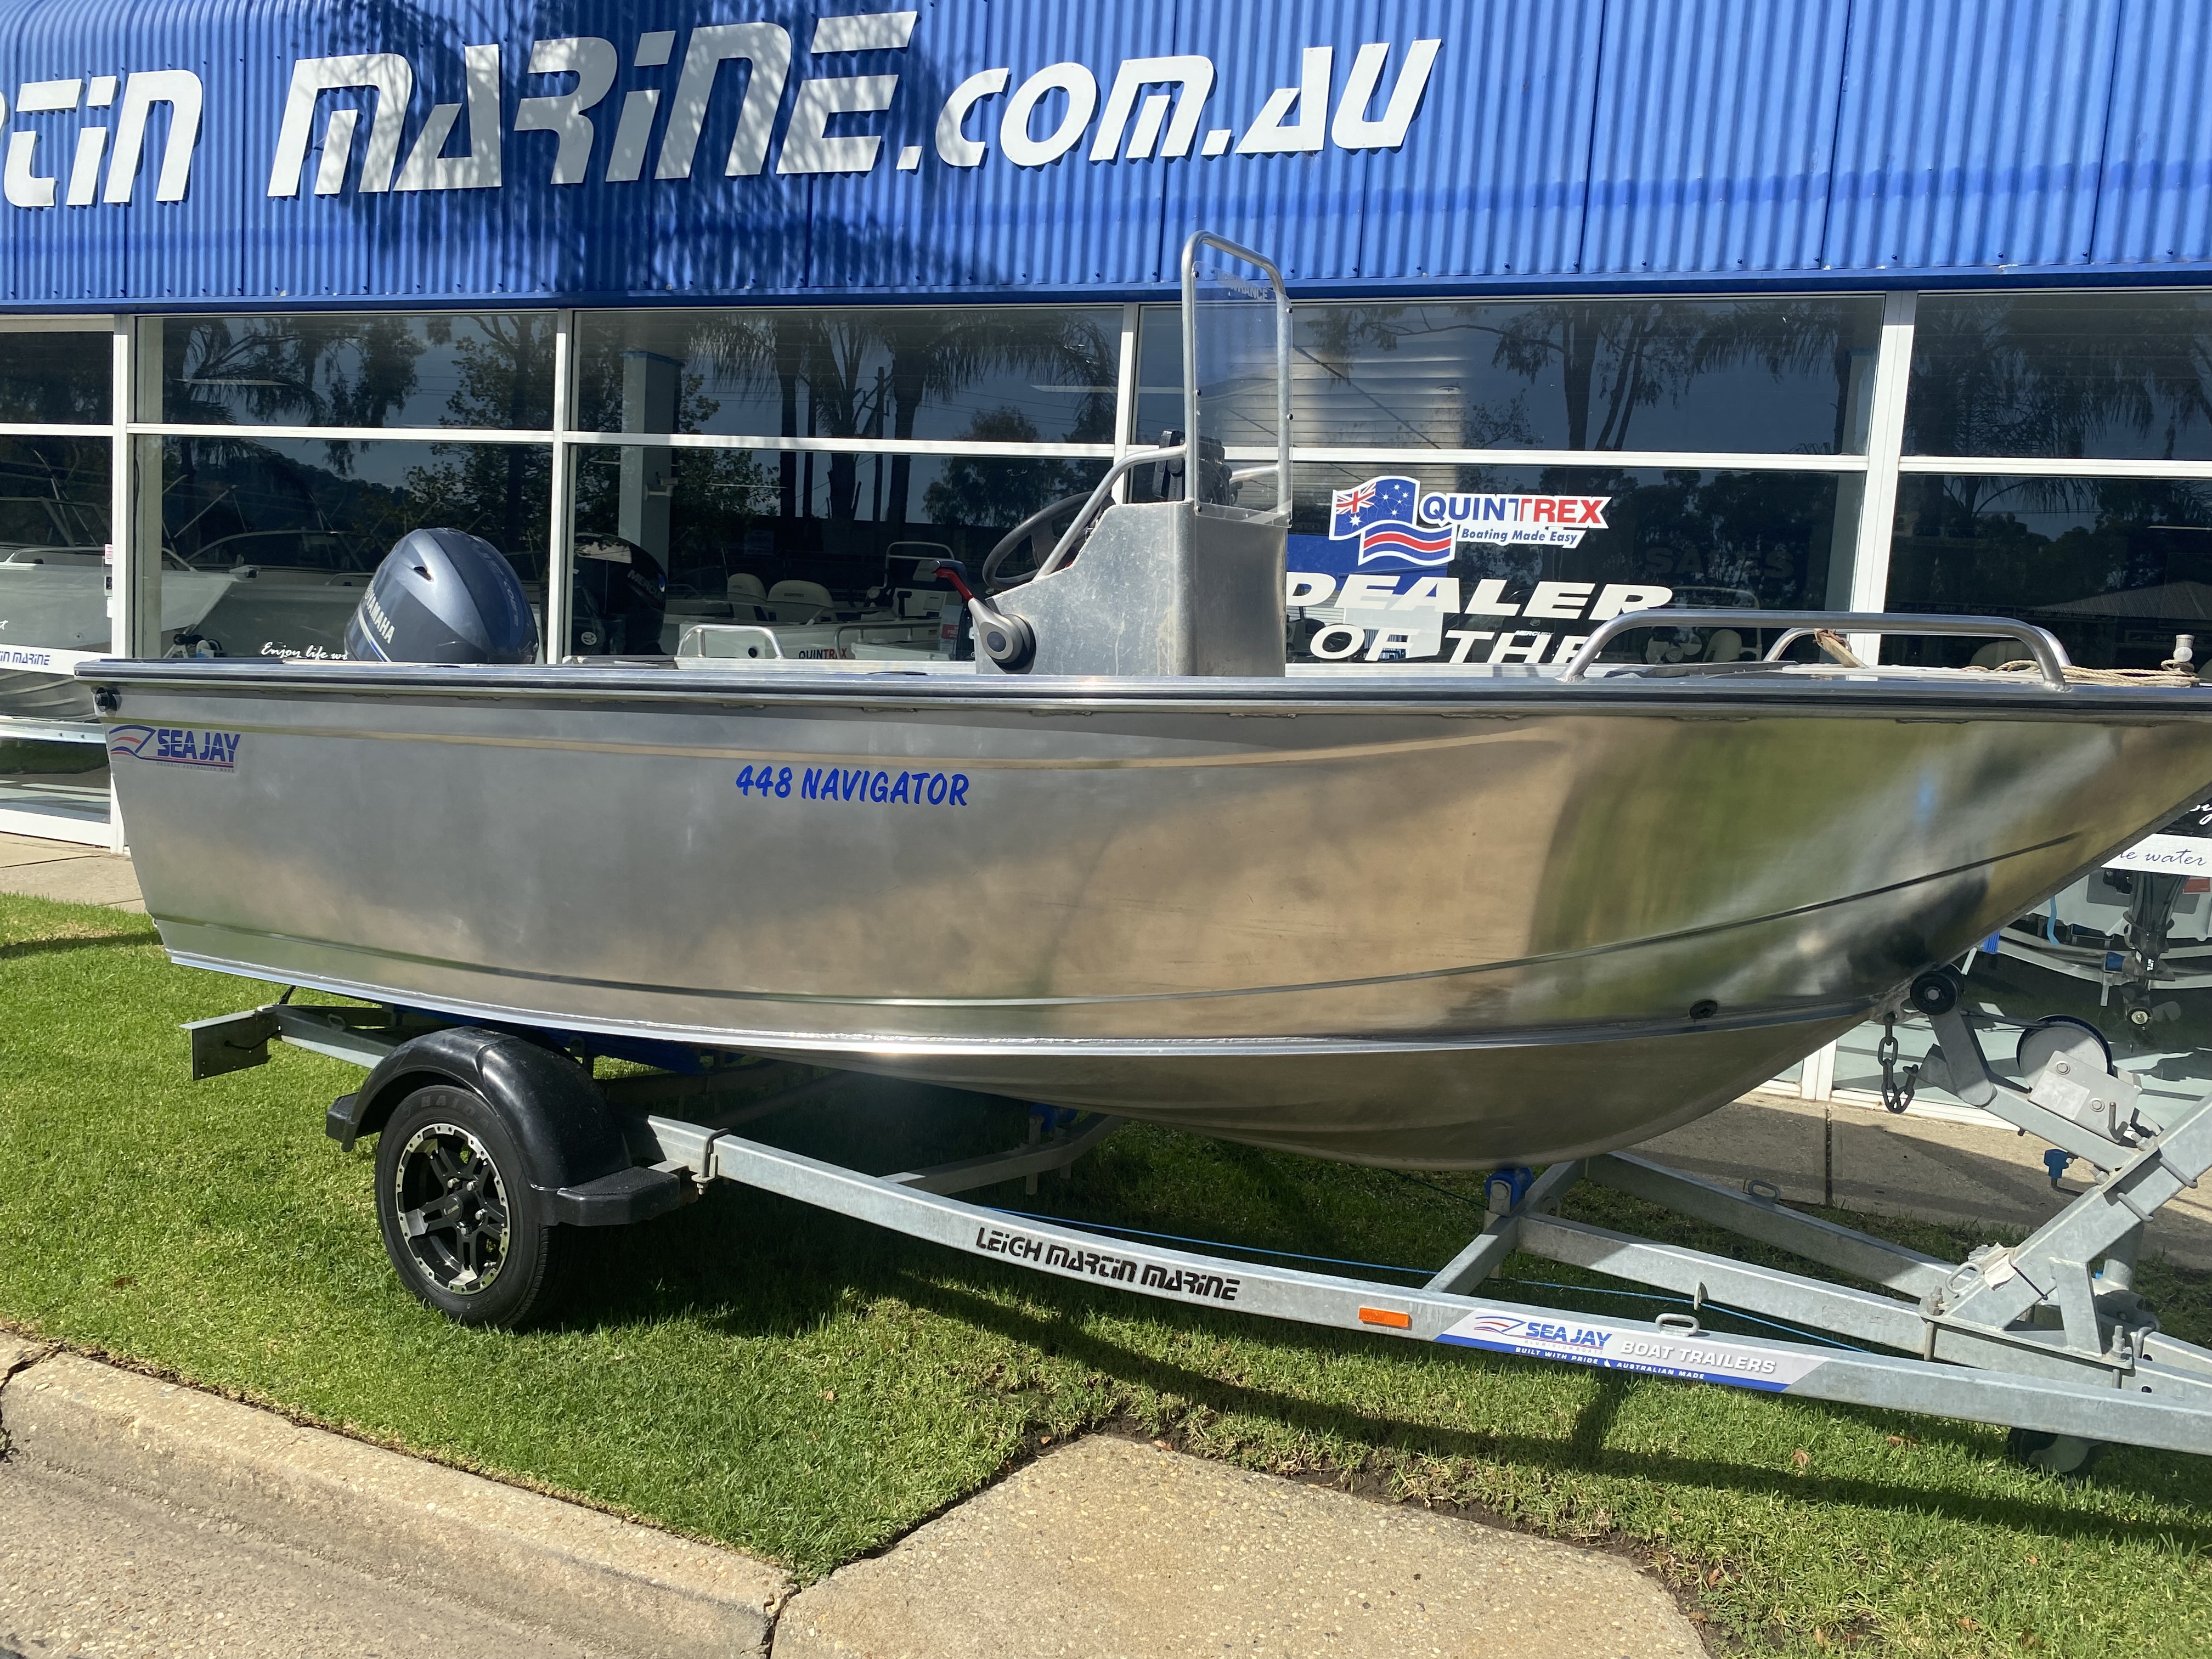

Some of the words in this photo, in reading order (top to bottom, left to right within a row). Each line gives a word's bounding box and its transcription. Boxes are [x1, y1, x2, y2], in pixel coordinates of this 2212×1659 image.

[0, 69, 203, 208] TIN
[1423, 495, 1604, 524] QUINTREX
[1461, 528, 1508, 541] Boating
[1512, 530, 1545, 540] Made
[1549, 531, 1578, 544] Easy
[1286, 572, 1673, 620] DEALER
[366, 589, 396, 645] YAMAHA
[261, 641, 302, 659] Enjoy
[305, 645, 329, 661] life
[1310, 624, 1421, 662] OF
[157, 729, 198, 760] SEA
[199, 732, 241, 763] JAY
[735, 764, 792, 798] 448
[801, 768, 970, 806] NAVIGATOR
[2145, 849, 2207, 866] water
[1525, 1322, 1567, 1343] SEA
[1570, 1329, 1613, 1347] JAY
[1515, 1346, 1541, 1356] BUILT
[1544, 1351, 1567, 1360] WITH
[1571, 1355, 1599, 1365] PRIDE
[1616, 1362, 1675, 1375] AUSTRALIAN
[1678, 1370, 1705, 1380] MADE
[1620, 1340, 1675, 1359] BOAT
[1679, 1347, 1778, 1374] TRAILERS
